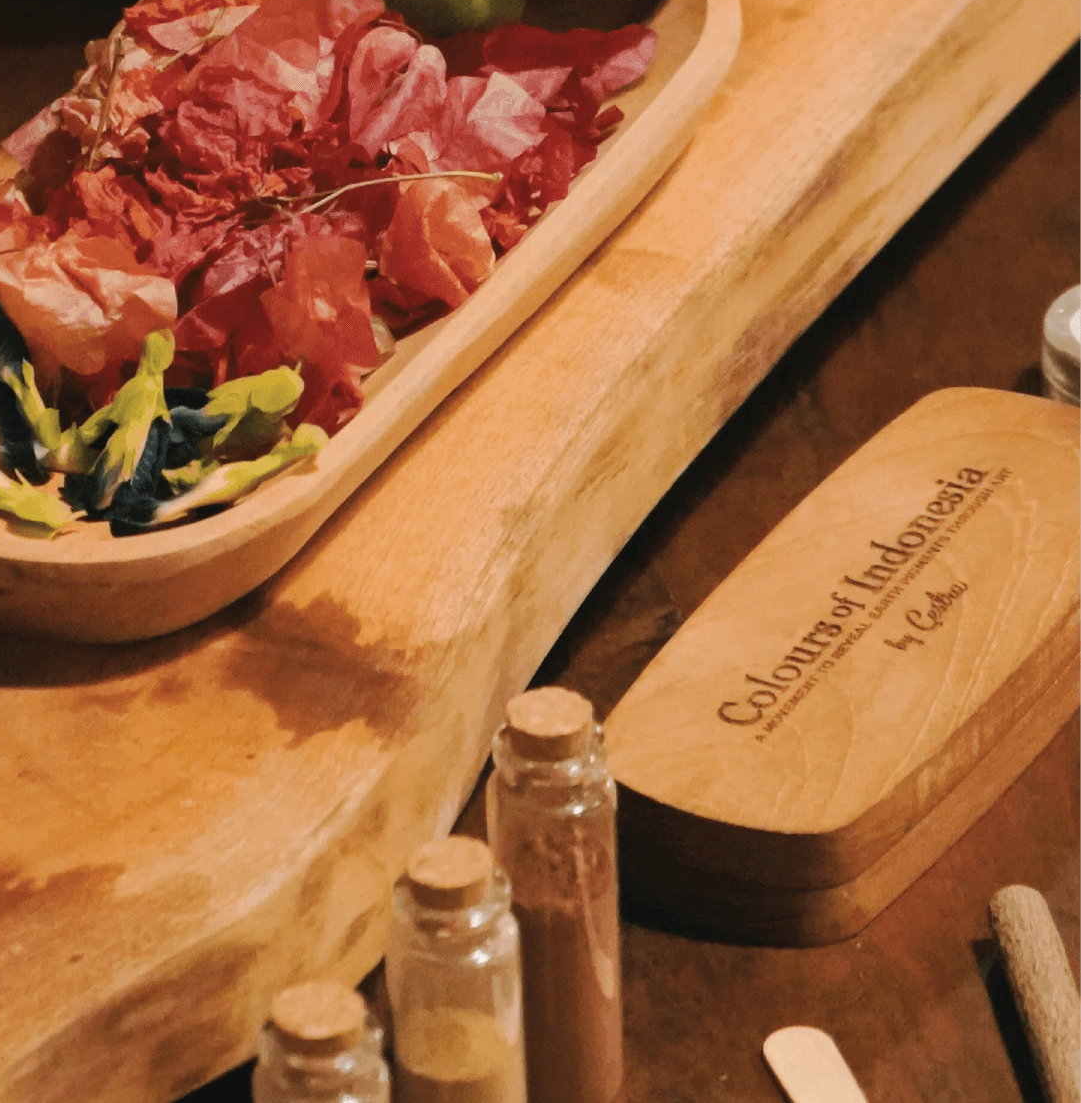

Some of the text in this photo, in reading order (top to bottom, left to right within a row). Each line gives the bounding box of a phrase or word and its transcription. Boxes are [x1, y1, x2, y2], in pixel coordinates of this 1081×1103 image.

[716, 467, 989, 727] Colours of Indonesia
[763, 675, 820, 733] MOVEMENT
[817, 658, 837, 674] TO
[831, 623, 873, 660] REVEAL
[868, 585, 904, 620] EARTH
[900, 536, 950, 587] PIGMENTS
[945, 488, 994, 534] THROUGH
[991, 467, 1013, 486] ART
[883, 633, 926, 651] by
